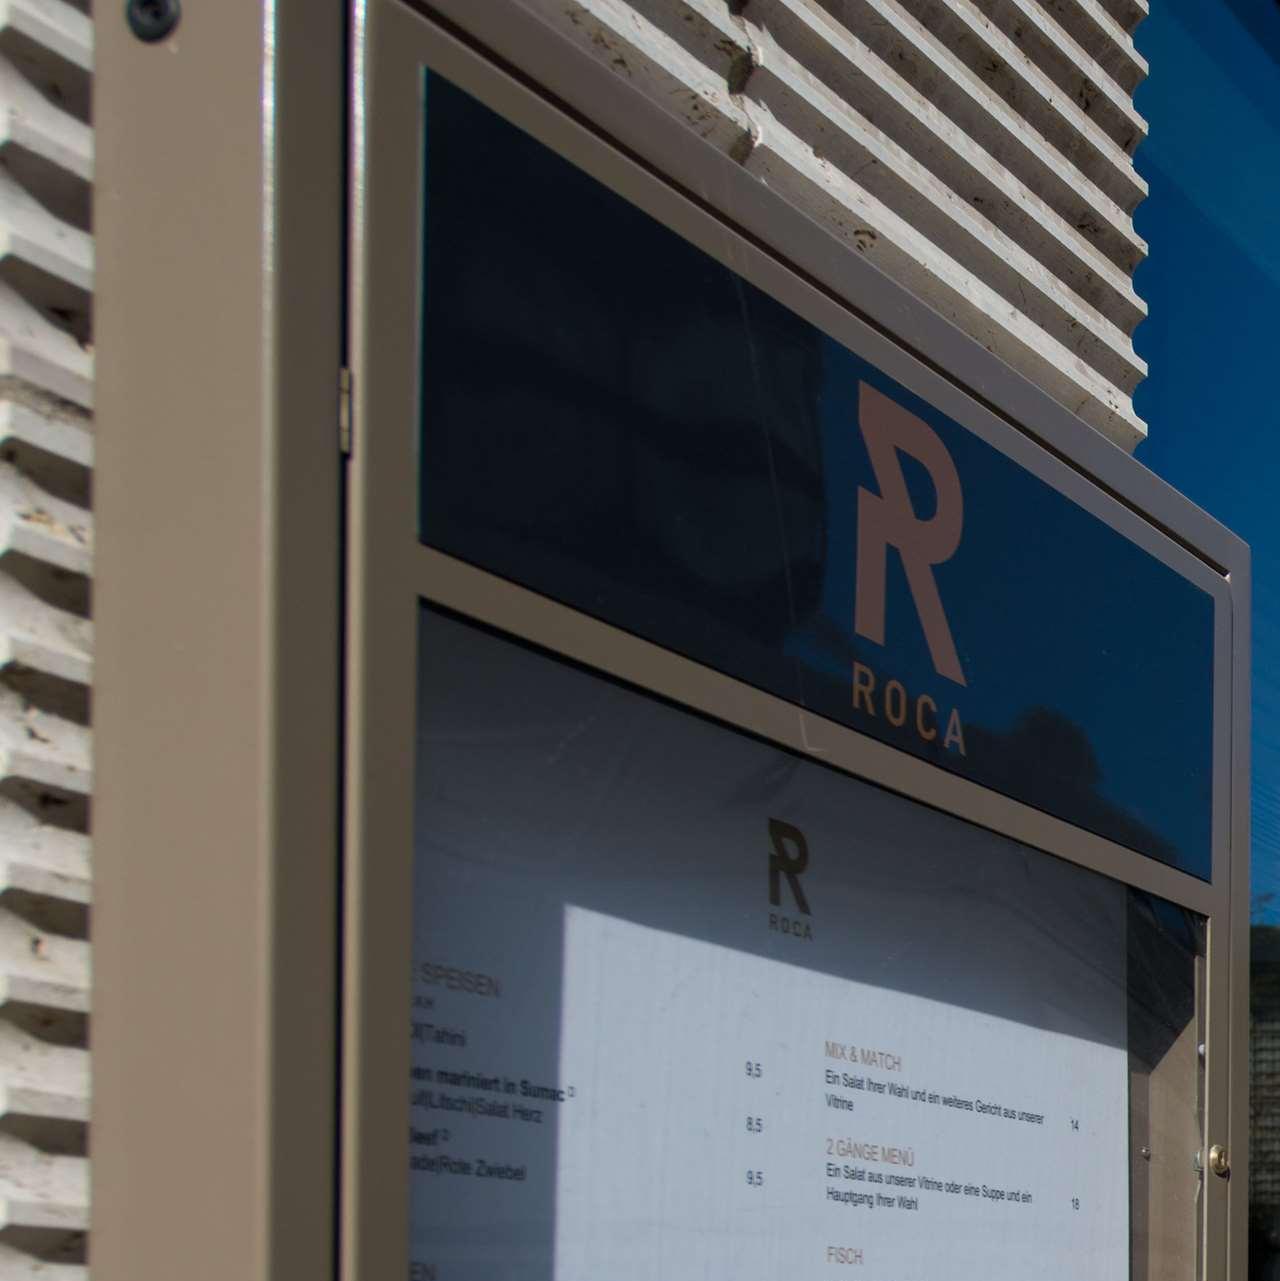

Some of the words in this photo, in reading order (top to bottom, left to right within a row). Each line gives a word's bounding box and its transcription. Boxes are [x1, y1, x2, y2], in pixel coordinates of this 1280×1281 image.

[854, 379, 967, 687] R
[852, 661, 966, 759] ROCA
[768, 818, 811, 916] R
[769, 913, 813, 941] ROCA
[825, 1041, 846, 1058] MIX
[851, 1047, 858, 1062] &
[861, 1048, 901, 1072] MATCH
[745, 1061, 762, 1078] 9,5
[520, 1081, 565, 1102] Sumac
[825, 1070, 840, 1085] Ein
[842, 1073, 864, 1090] Salat
[867, 1078, 885, 1094] Ihrer
[889, 1082, 909, 1098] Wahl
[911, 1088, 926, 1101] und
[929, 1091, 940, 1104] ein
[943, 1094, 973, 1112] weiteres
[976, 1100, 1001, 1117] Gericht
[1003, 1107, 1016, 1119] aus
[1018, 1109, 1044, 1124] unserer
[825, 1093, 853, 1111] Vitrine
[1071, 1118, 1079, 1132] 14
[827, 1139, 833, 1155] 2
[836, 1137, 879, 1162] GÄNGE
[881, 1146, 914, 1167] MENÜ
[747, 1171, 763, 1187] 9,5
[827, 1163, 840, 1178] Ein
[843, 1165, 865, 1182] Salat
[868, 1170, 883, 1184] aus
[886, 1173, 916, 1188] unserer
[919, 1176, 943, 1191] Vitrine
[945, 1179, 962, 1194] oder
[964, 1182, 980, 1196] eine
[982, 1185, 1005, 1202] Suppe
[1007, 1189, 1020, 1201] und
[1022, 1191, 1032, 1203] ein
[827, 1187, 874, 1208] Hauptgang
[876, 1192, 895, 1207] Ihrer
[898, 1194, 918, 1210] Wahl
[1072, 1198, 1080, 1211] 18
[828, 1247, 863, 1264] FISCH
